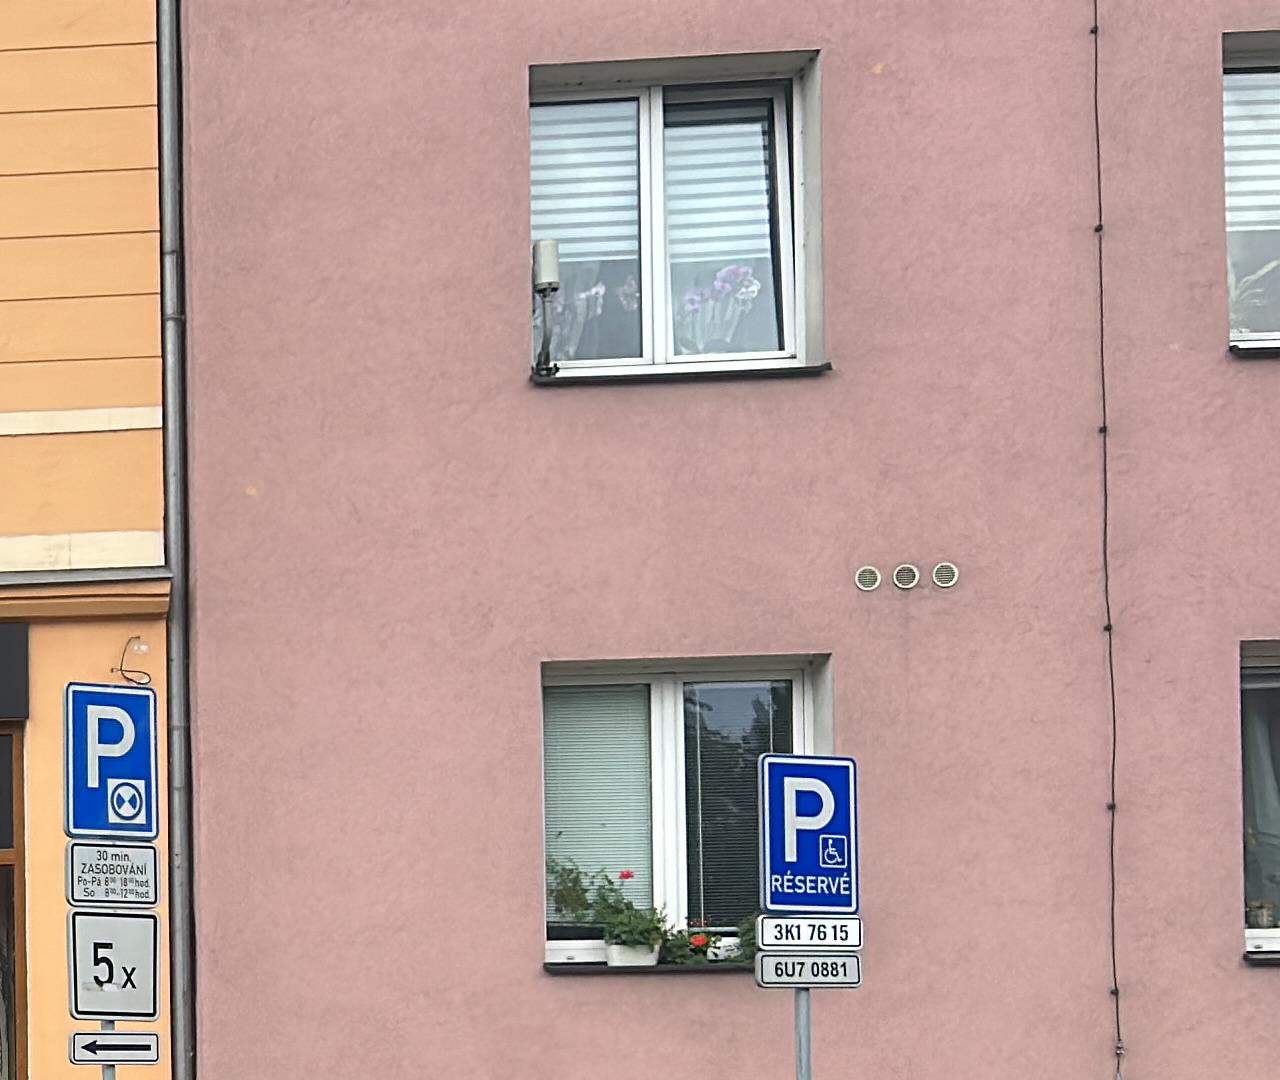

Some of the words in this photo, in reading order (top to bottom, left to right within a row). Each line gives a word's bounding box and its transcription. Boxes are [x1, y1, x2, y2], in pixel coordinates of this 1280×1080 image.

[87, 704, 136, 788] P
[784, 776, 835, 862] P
[96, 850, 108, 861] 30
[111, 851, 131, 862] min.
[81, 862, 147, 875] ZASOBOVÁNÍ
[77, 876, 102, 886] Po-Pá
[772, 870, 851, 894] RÉSERVÉ
[83, 887, 96, 897] So
[774, 924, 801, 941] 3K1
[774, 961, 806, 977] 6U7
[811, 962, 847, 977] 0881
